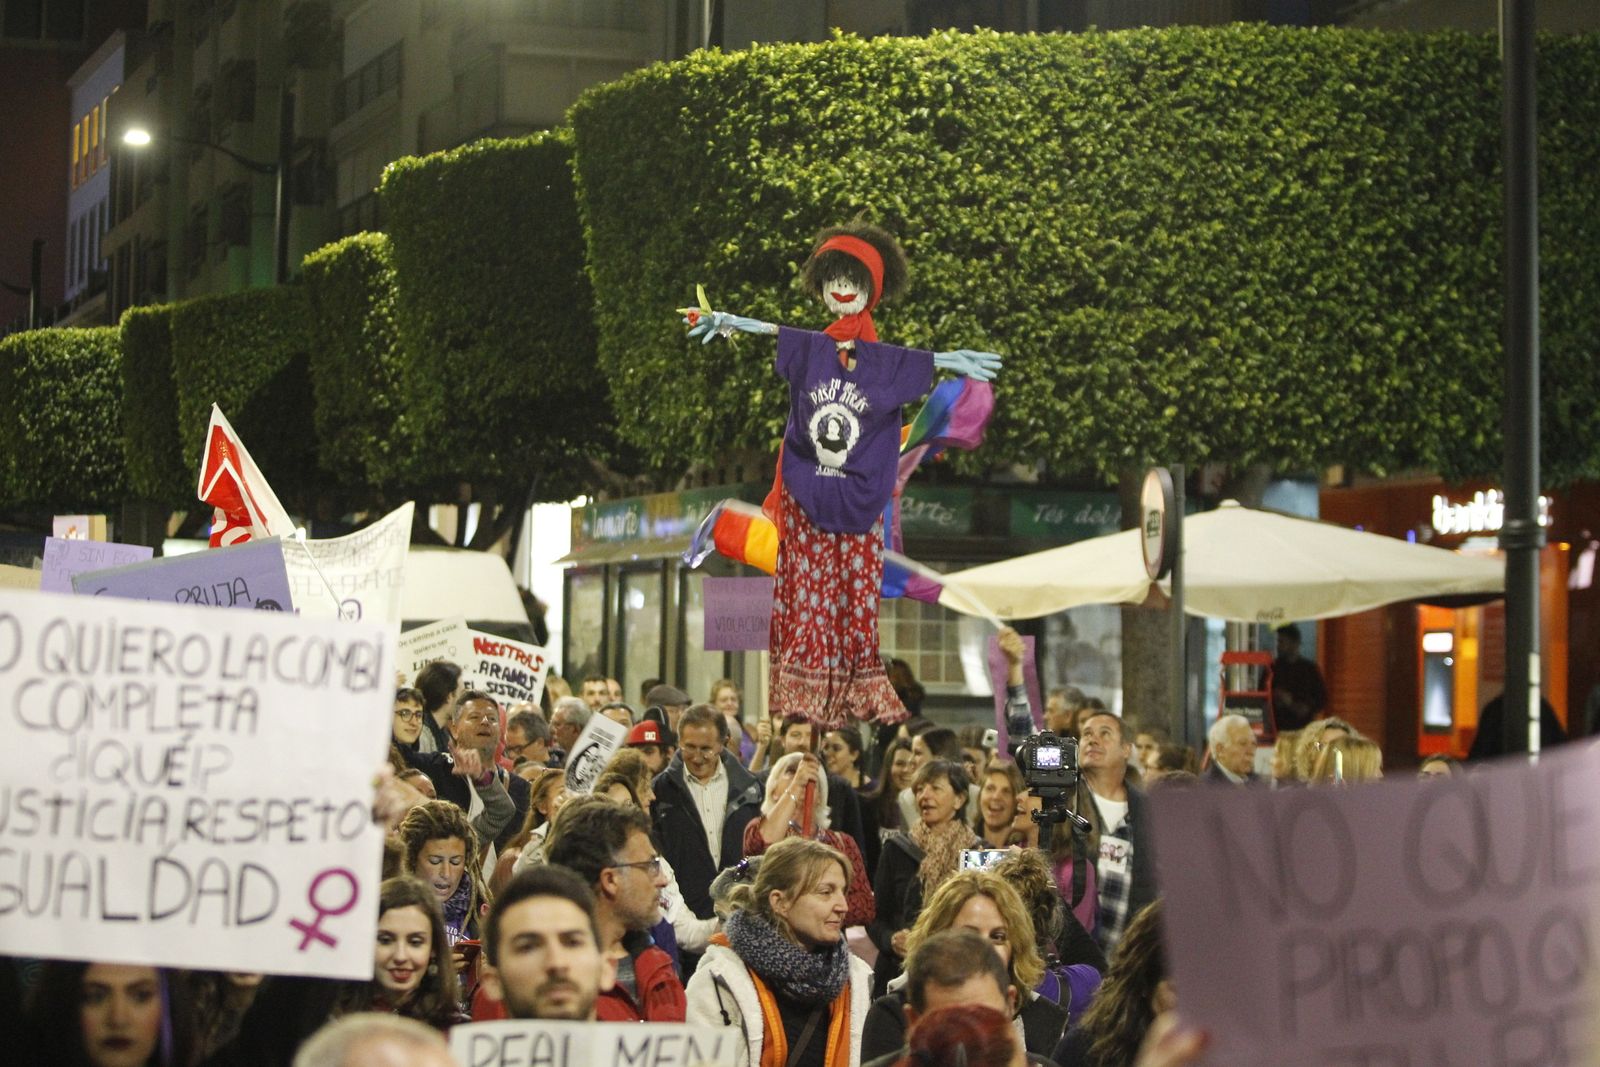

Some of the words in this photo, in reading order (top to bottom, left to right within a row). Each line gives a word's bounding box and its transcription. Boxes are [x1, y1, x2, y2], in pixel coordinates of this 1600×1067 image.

[810, 387, 836, 405] PASO
[38, 617, 211, 678] QUIERO
[220, 632, 270, 683] LA
[272, 631, 385, 693] COMBI
[473, 660, 538, 691] ARAMOS
[180, 795, 368, 845] RESPETO
[1206, 793, 1358, 922] NO
